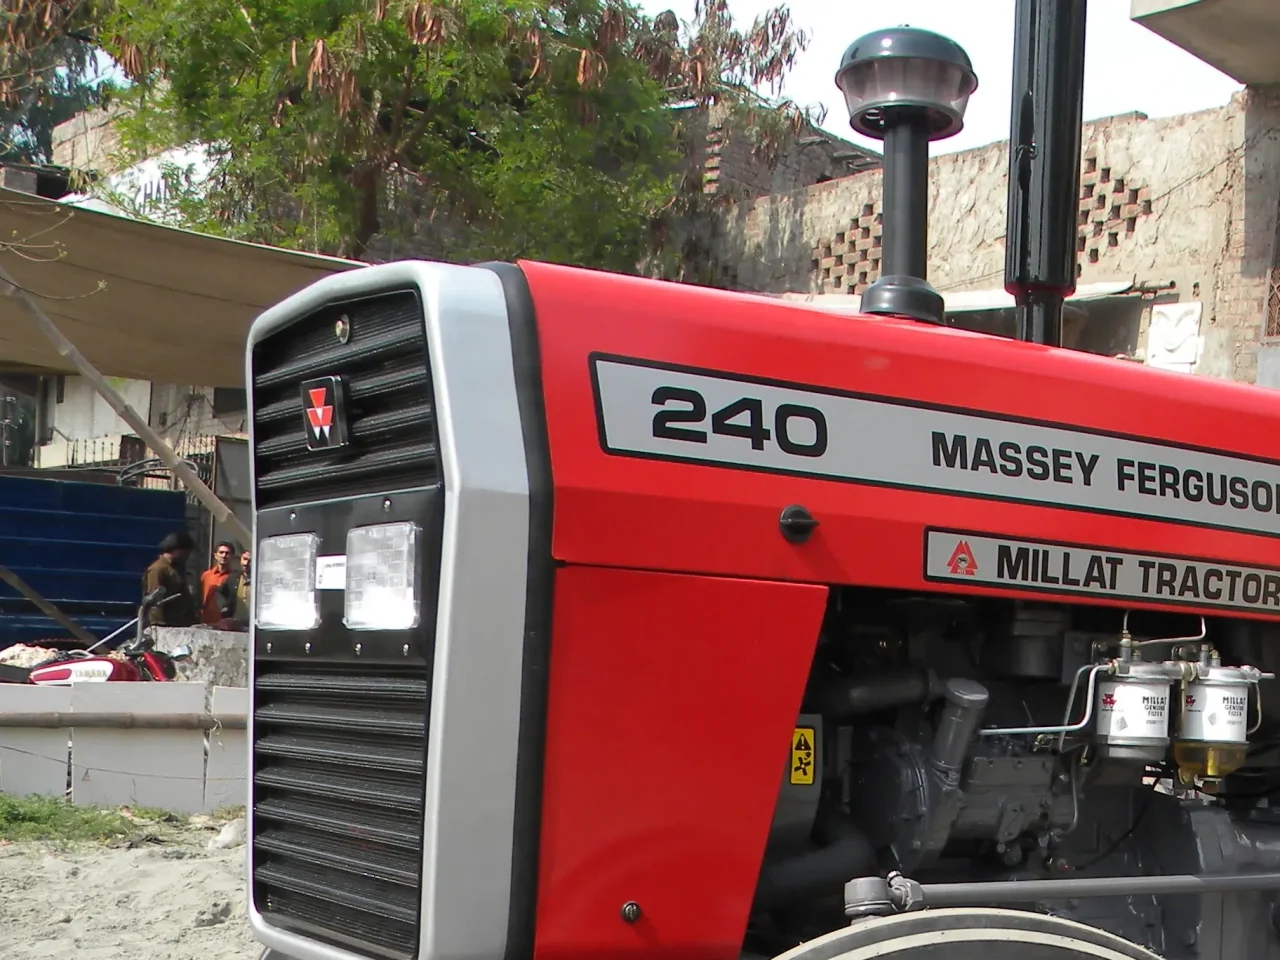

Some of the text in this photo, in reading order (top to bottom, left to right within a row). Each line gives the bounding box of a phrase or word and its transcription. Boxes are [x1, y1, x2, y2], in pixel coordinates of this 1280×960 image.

[651, 385, 828, 458] 240
[931, 431, 1100, 486] MASSEY
[997, 545, 1123, 590] MILLAT
[74, 669, 108, 678] YAMAHA
[1142, 696, 1167, 705] MILLAT
[1222, 696, 1246, 705] MILLAT
